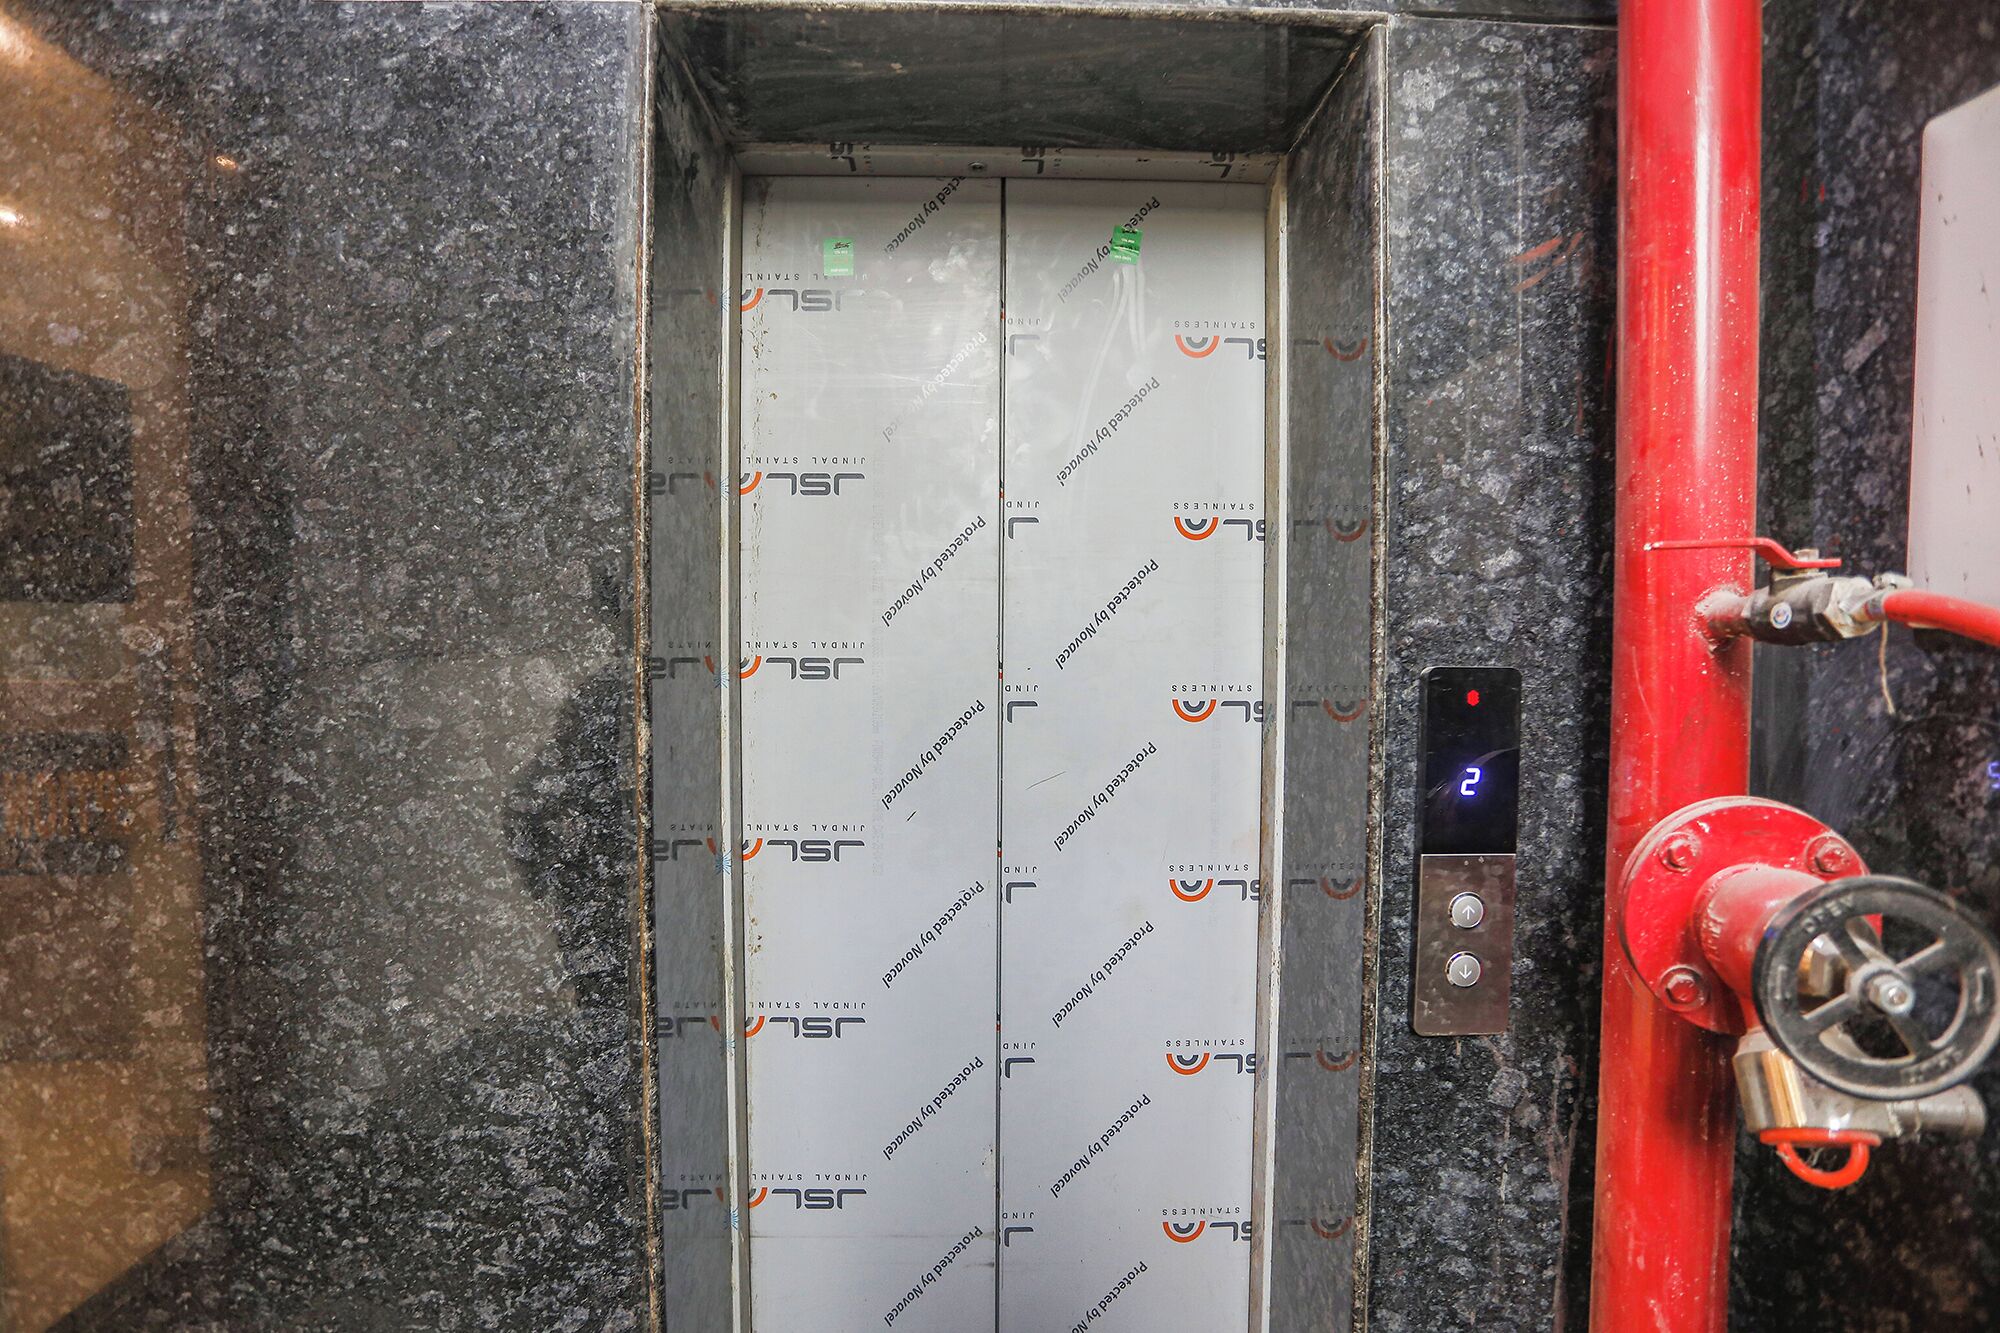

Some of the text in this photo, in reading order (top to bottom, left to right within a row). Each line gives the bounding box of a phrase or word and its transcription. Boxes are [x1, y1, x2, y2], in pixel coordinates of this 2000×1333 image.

[923, 200, 939, 217] by
[1110, 197, 1160, 245] Protec
[1058, 259, 1099, 304] Novacel
[768, 289, 865, 312] JSL
[1174, 320, 1256, 329] STAINLESS
[1057, 377, 1160, 486] Protected by Novacel
[766, 473, 865, 496] JSL
[1004, 503, 1039, 511] JIND
[882, 516, 986, 627] Protected by Novacel
[1055, 559, 1159, 670] Protected by Novacel
[766, 657, 864, 680] JSL
[882, 700, 985, 810] Protected by Novacel
[1460, 768, 1482, 796] 2
[1054, 742, 1157, 852] Protected by Novacel
[767, 840, 865, 862] JSL
[1169, 864, 1248, 872] STAINLESS
[882, 881, 984, 989] Protected by Novacel
[1052, 921, 1154, 1028] Protected by Novacel
[769, 1017, 865, 1038] JSL
[1166, 1039, 1244, 1047] STAINLESS
[883, 1056, 983, 1160] Protected by Novacel
[1050, 1094, 1151, 1198] Protected by Novacel
[772, 1189, 867, 1209] JSL
[1162, 1207, 1239, 1217] STAINLESS
[884, 1226, 983, 1327] Protected by Novacel
[1098, 1261, 1148, 1312] Protected
[1086, 1308, 1101, 1323] by
